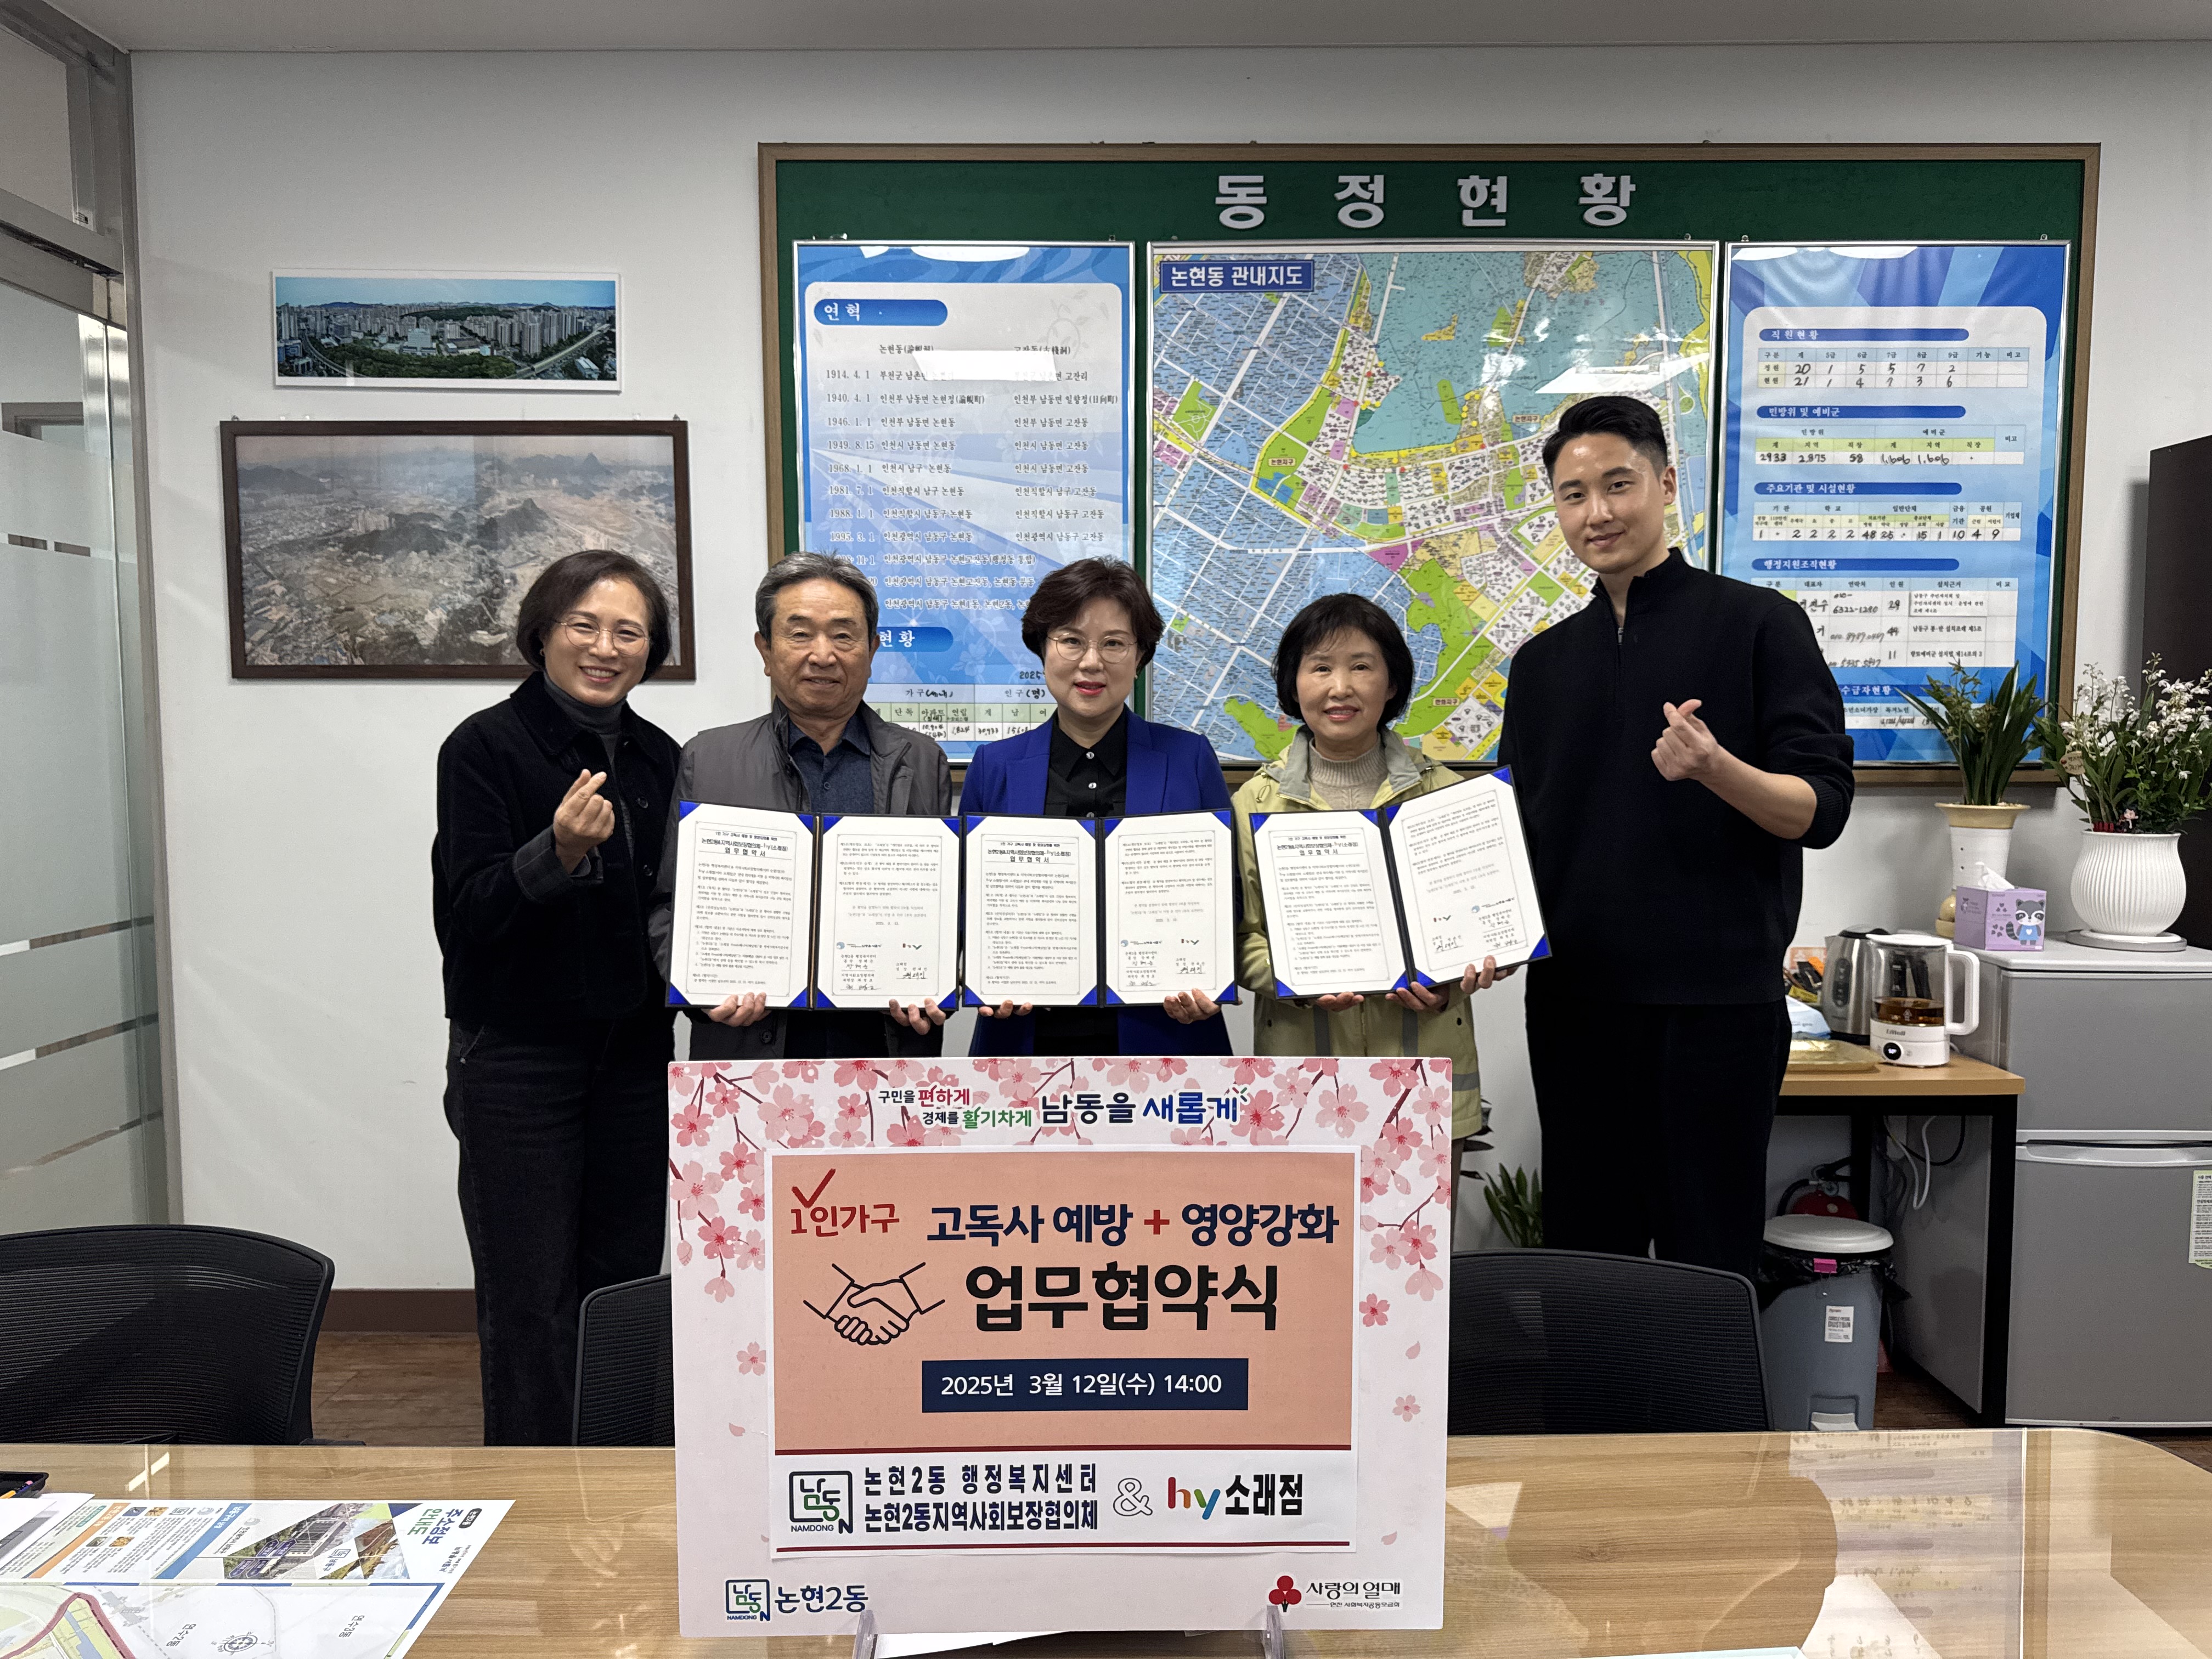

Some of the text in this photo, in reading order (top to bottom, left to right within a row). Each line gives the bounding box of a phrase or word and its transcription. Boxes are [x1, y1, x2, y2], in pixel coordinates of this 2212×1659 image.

[1171, 266, 1303, 287] 논현동 관내지도
[1795, 363, 1812, 375] 20
[1065, 371, 1088, 381] 고잔리
[1946, 375, 1953, 388] 6
[880, 393, 904, 404] 인천부
[906, 393, 929, 404] 남동면
[1014, 394, 1063, 405] 인천부 남동면
[1812, 407, 1841, 417] 예비군
[881, 417, 904, 428] 인천부
[906, 417, 930, 428] 남동면
[932, 417, 956, 428] 논현동
[1014, 417, 1089, 428] 인천부 남동면 고잔동
[881, 440, 904, 451] 인천시
[907, 440, 930, 451] 남동면
[932, 440, 956, 451] 논현동
[1014, 441, 1089, 451] 인천시 남동면 고잔동
[881, 463, 904, 473] 인천시
[907, 463, 923, 473] 남구
[928, 463, 952, 473] 논현동
[1014, 464, 1089, 474] 인천시 남동면 고잔동
[882, 486, 920, 496] 인천직할시
[923, 486, 939, 496] 남구
[941, 486, 964, 496] 논현동
[1015, 487, 1097, 497] 인천직할시 남구 고잔동
[883, 509, 921, 519] 인천직할시
[924, 509, 947, 519] 남동구
[949, 509, 973, 519] 논현동
[1015, 509, 1105, 520] 인천직할시 남동구 고잔동
[883, 531, 922, 541] 인천광역시
[924, 531, 947, 541] 남동구
[949, 531, 973, 541] 논현동
[1015, 532, 1105, 542] 인천광역시 남동구 고잔동
[884, 554, 922, 565] 인천광역시
[926, 554, 948, 565] 남동구
[884, 577, 1017, 588] 인천광역시 남동구 논현동
[885, 599, 923, 610] 인천광역시
[926, 599, 949, 610] 남동구
[878, 1086, 970, 1108] 구민을 편하게
[1042, 1092, 1239, 1125] 남동을 새롭게
[922, 1105, 1032, 1129] 경제를 활기차게
[790, 1202, 901, 1237] 1인가구
[926, 1204, 1045, 1247] 고독사
[1052, 1204, 1132, 1247] 예방
[1181, 1201, 1340, 1247] 영양강화
[966, 1260, 1279, 1333] 업무협약식
[940, 1371, 1223, 1397] 2025년 3월 12일(수) 14:00
[864, 1463, 1097, 1496] 논현2동 행정복지센터
[865, 1499, 1098, 1533] 논현2동지역사회보장협의체
[407, 1508, 443, 1536] 안내도
[421, 1508, 464, 1545] 주소정보
[791, 1524, 834, 1532] NAMDONG
[1306, 1582, 1401, 1600] 사랑의 열매
[774, 1584, 869, 1614] 논현2동
